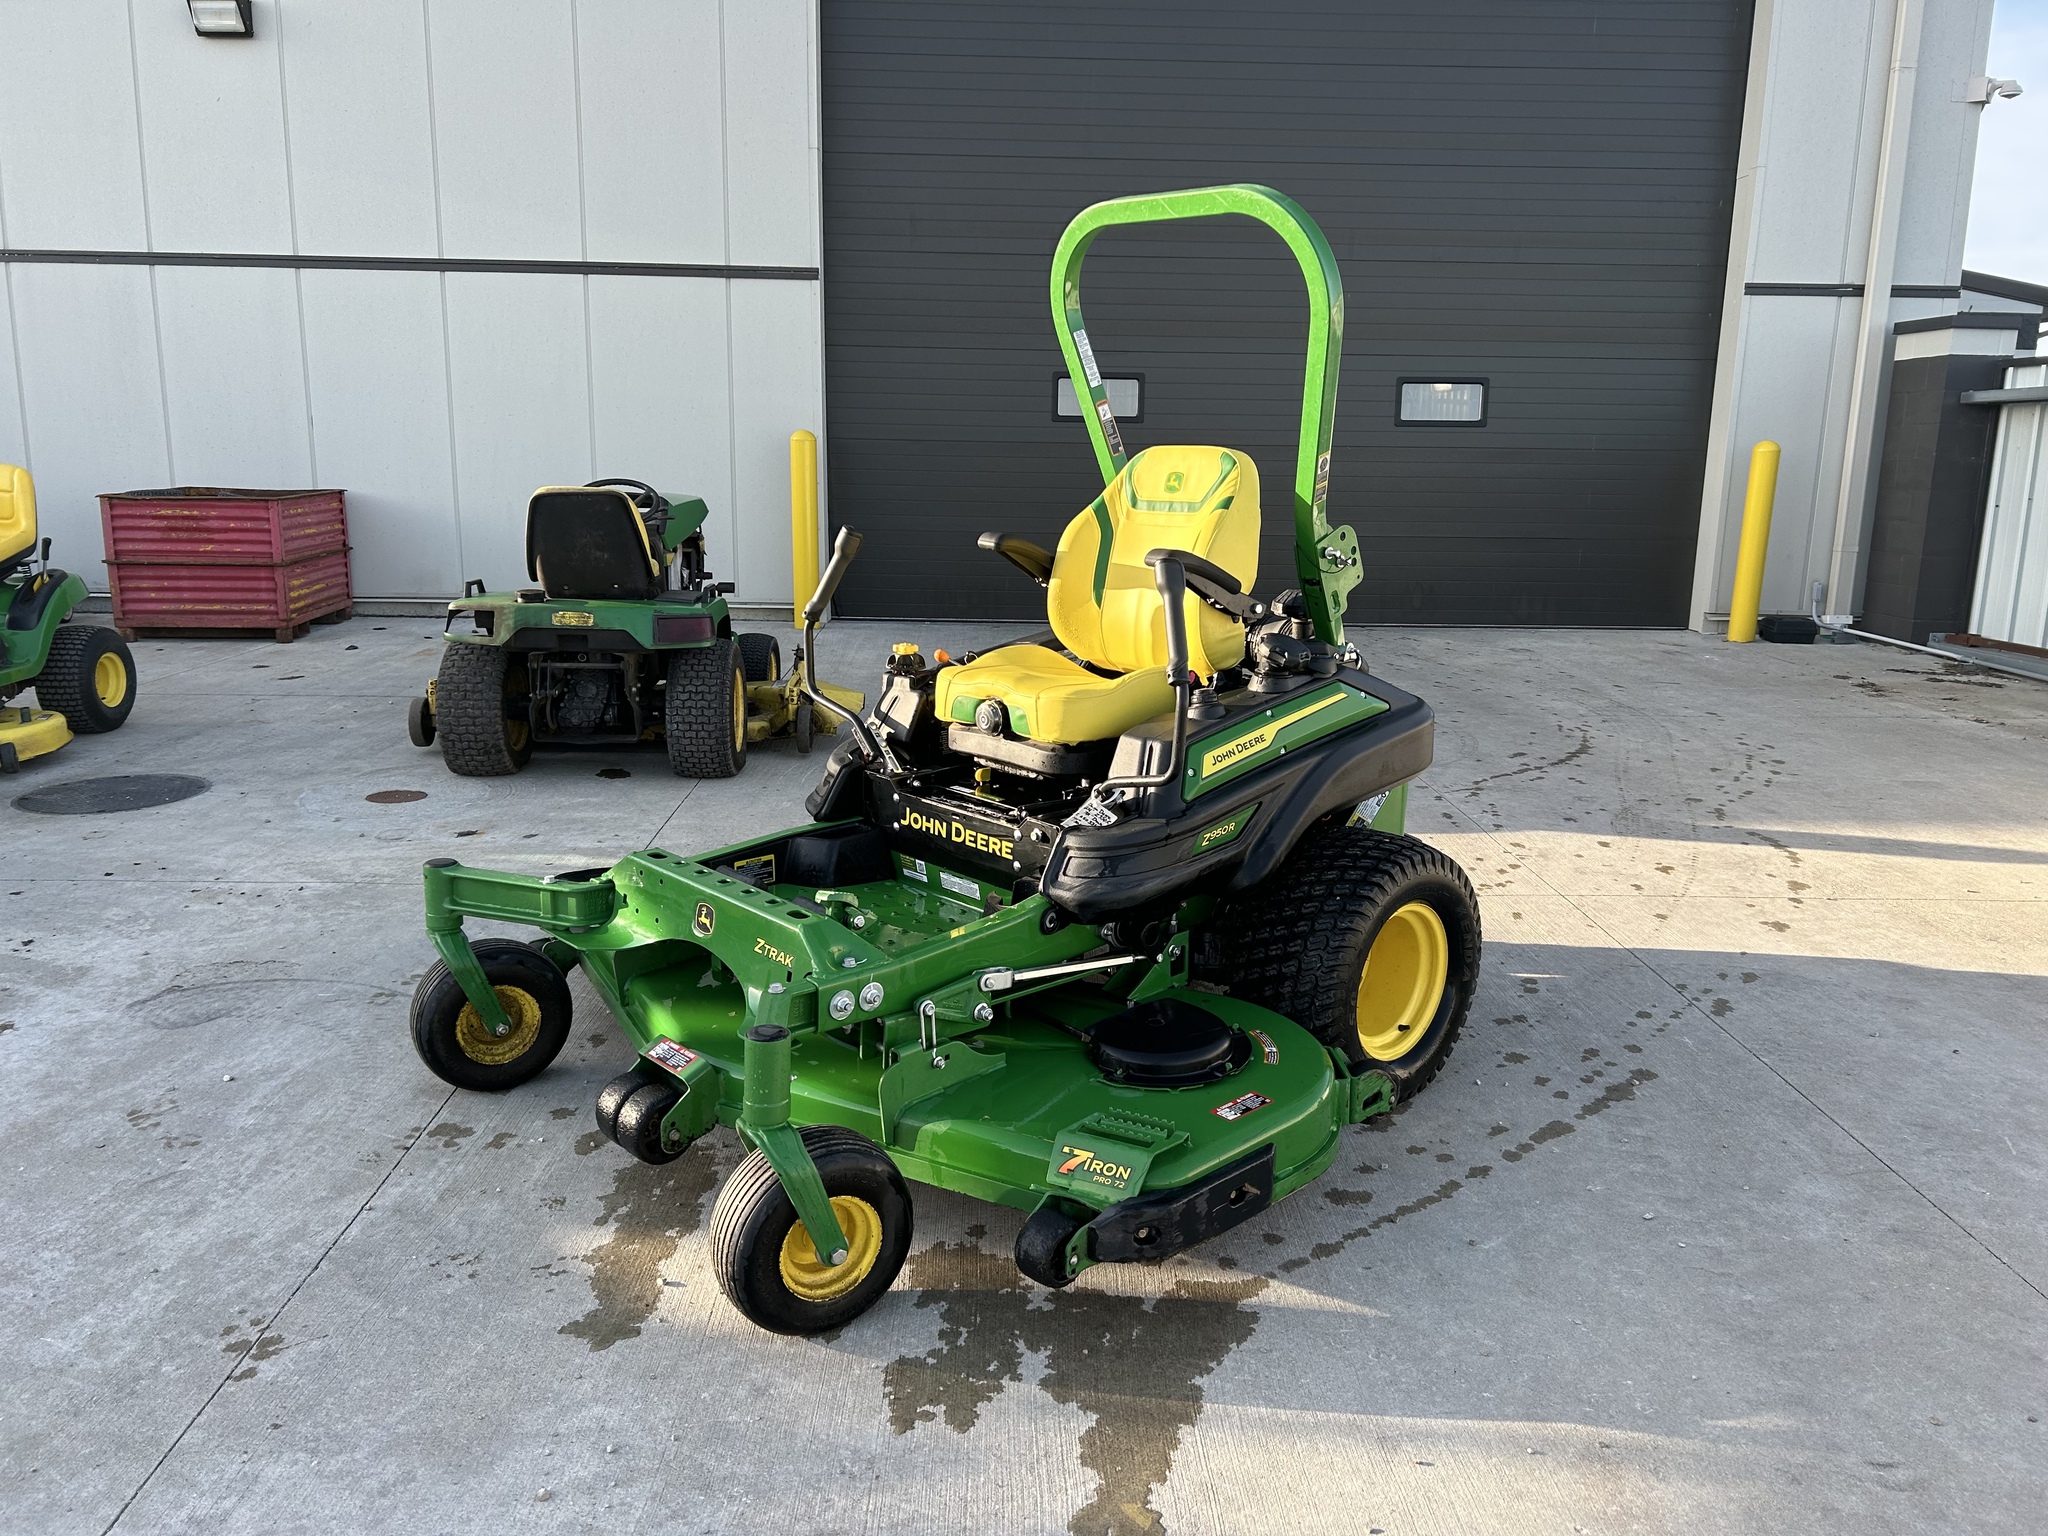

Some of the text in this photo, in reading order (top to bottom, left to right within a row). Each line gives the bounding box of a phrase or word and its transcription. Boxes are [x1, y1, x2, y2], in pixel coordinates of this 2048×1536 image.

[1212, 734, 1266, 766] JOHN DEERE
[900, 807, 1014, 860] JOHN DEERE
[1201, 822, 1236, 847] Z950R
[753, 937, 795, 968] ZTRAK
[1457, 907, 1474, 981] KENDA
[1092, 1175, 1126, 1189] PRO 72
